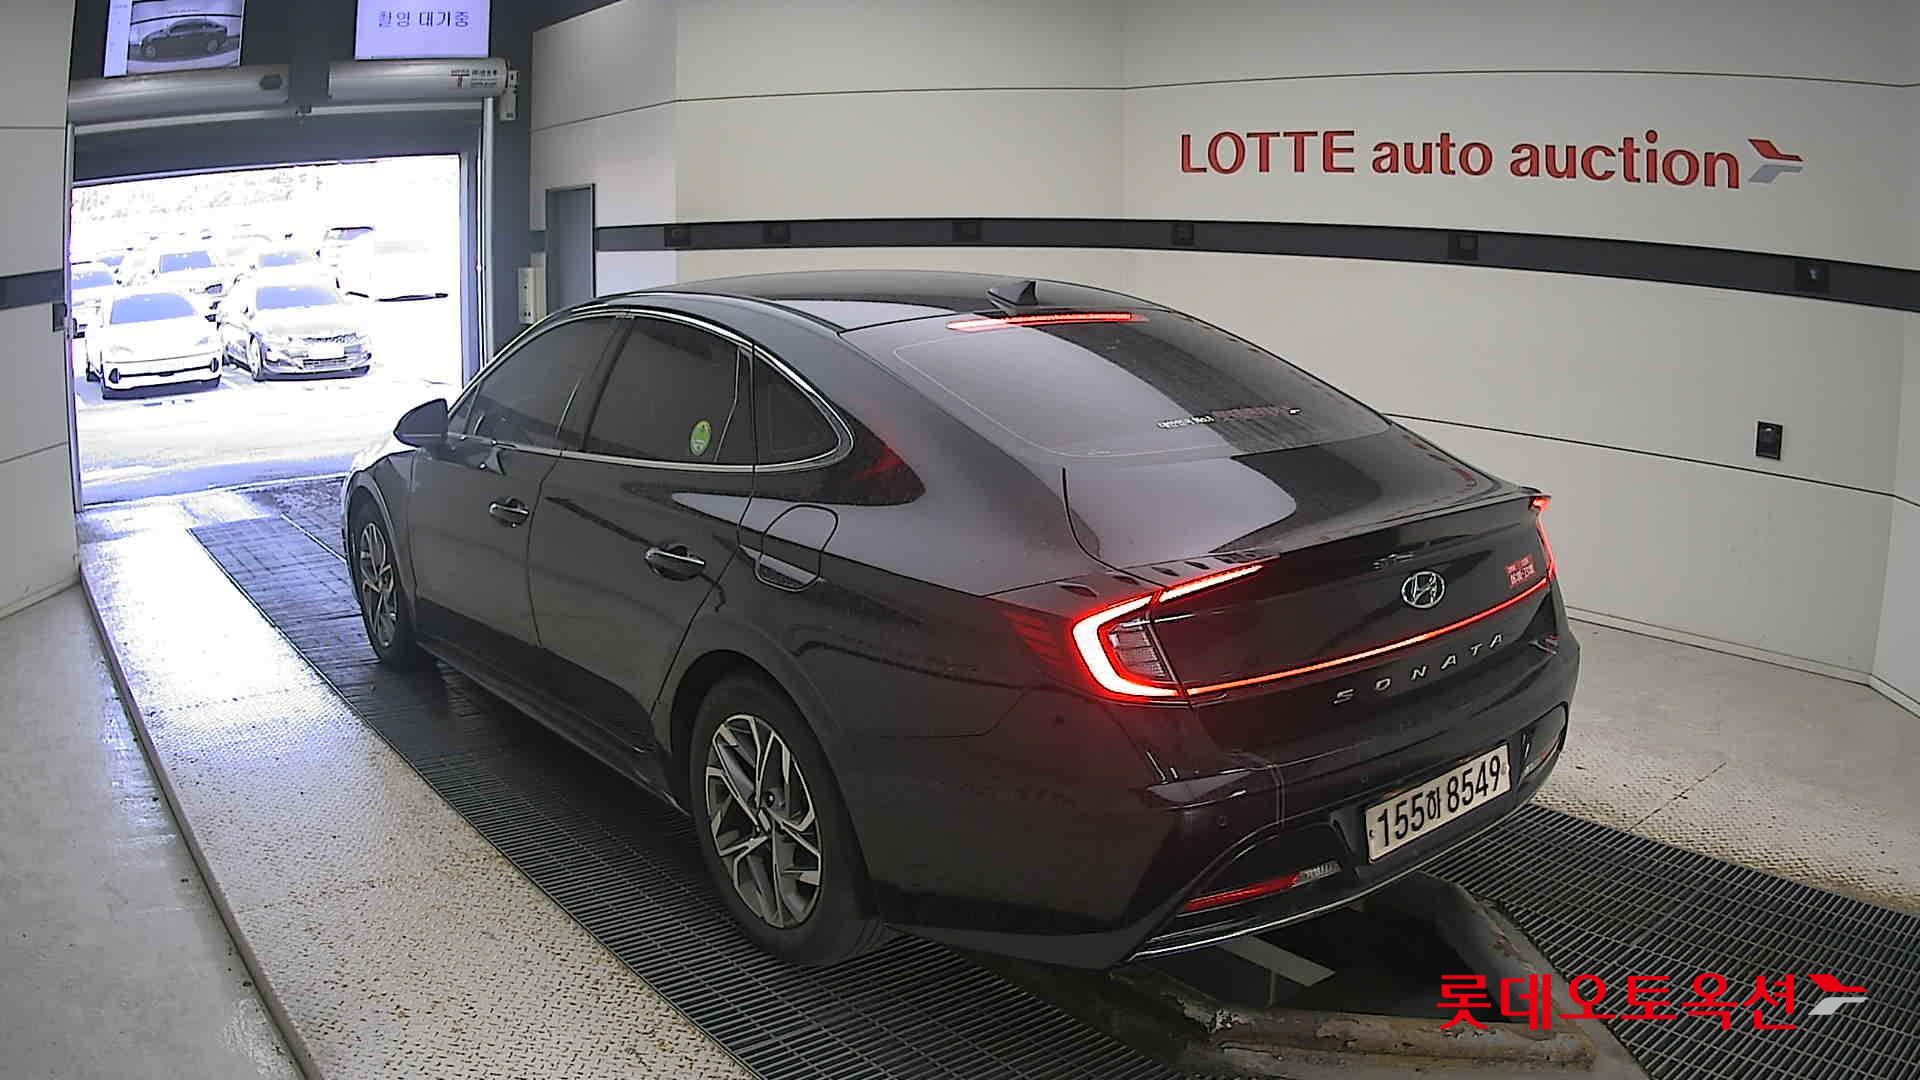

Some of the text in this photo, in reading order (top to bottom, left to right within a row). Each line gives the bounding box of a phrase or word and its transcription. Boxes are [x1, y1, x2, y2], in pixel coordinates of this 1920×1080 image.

[419, 10, 470, 28] 대기중
[1179, 129, 1741, 190] LOTTE auto auction
[1333, 633, 1503, 704] SONATA
[1446, 755, 1501, 813] 8549
